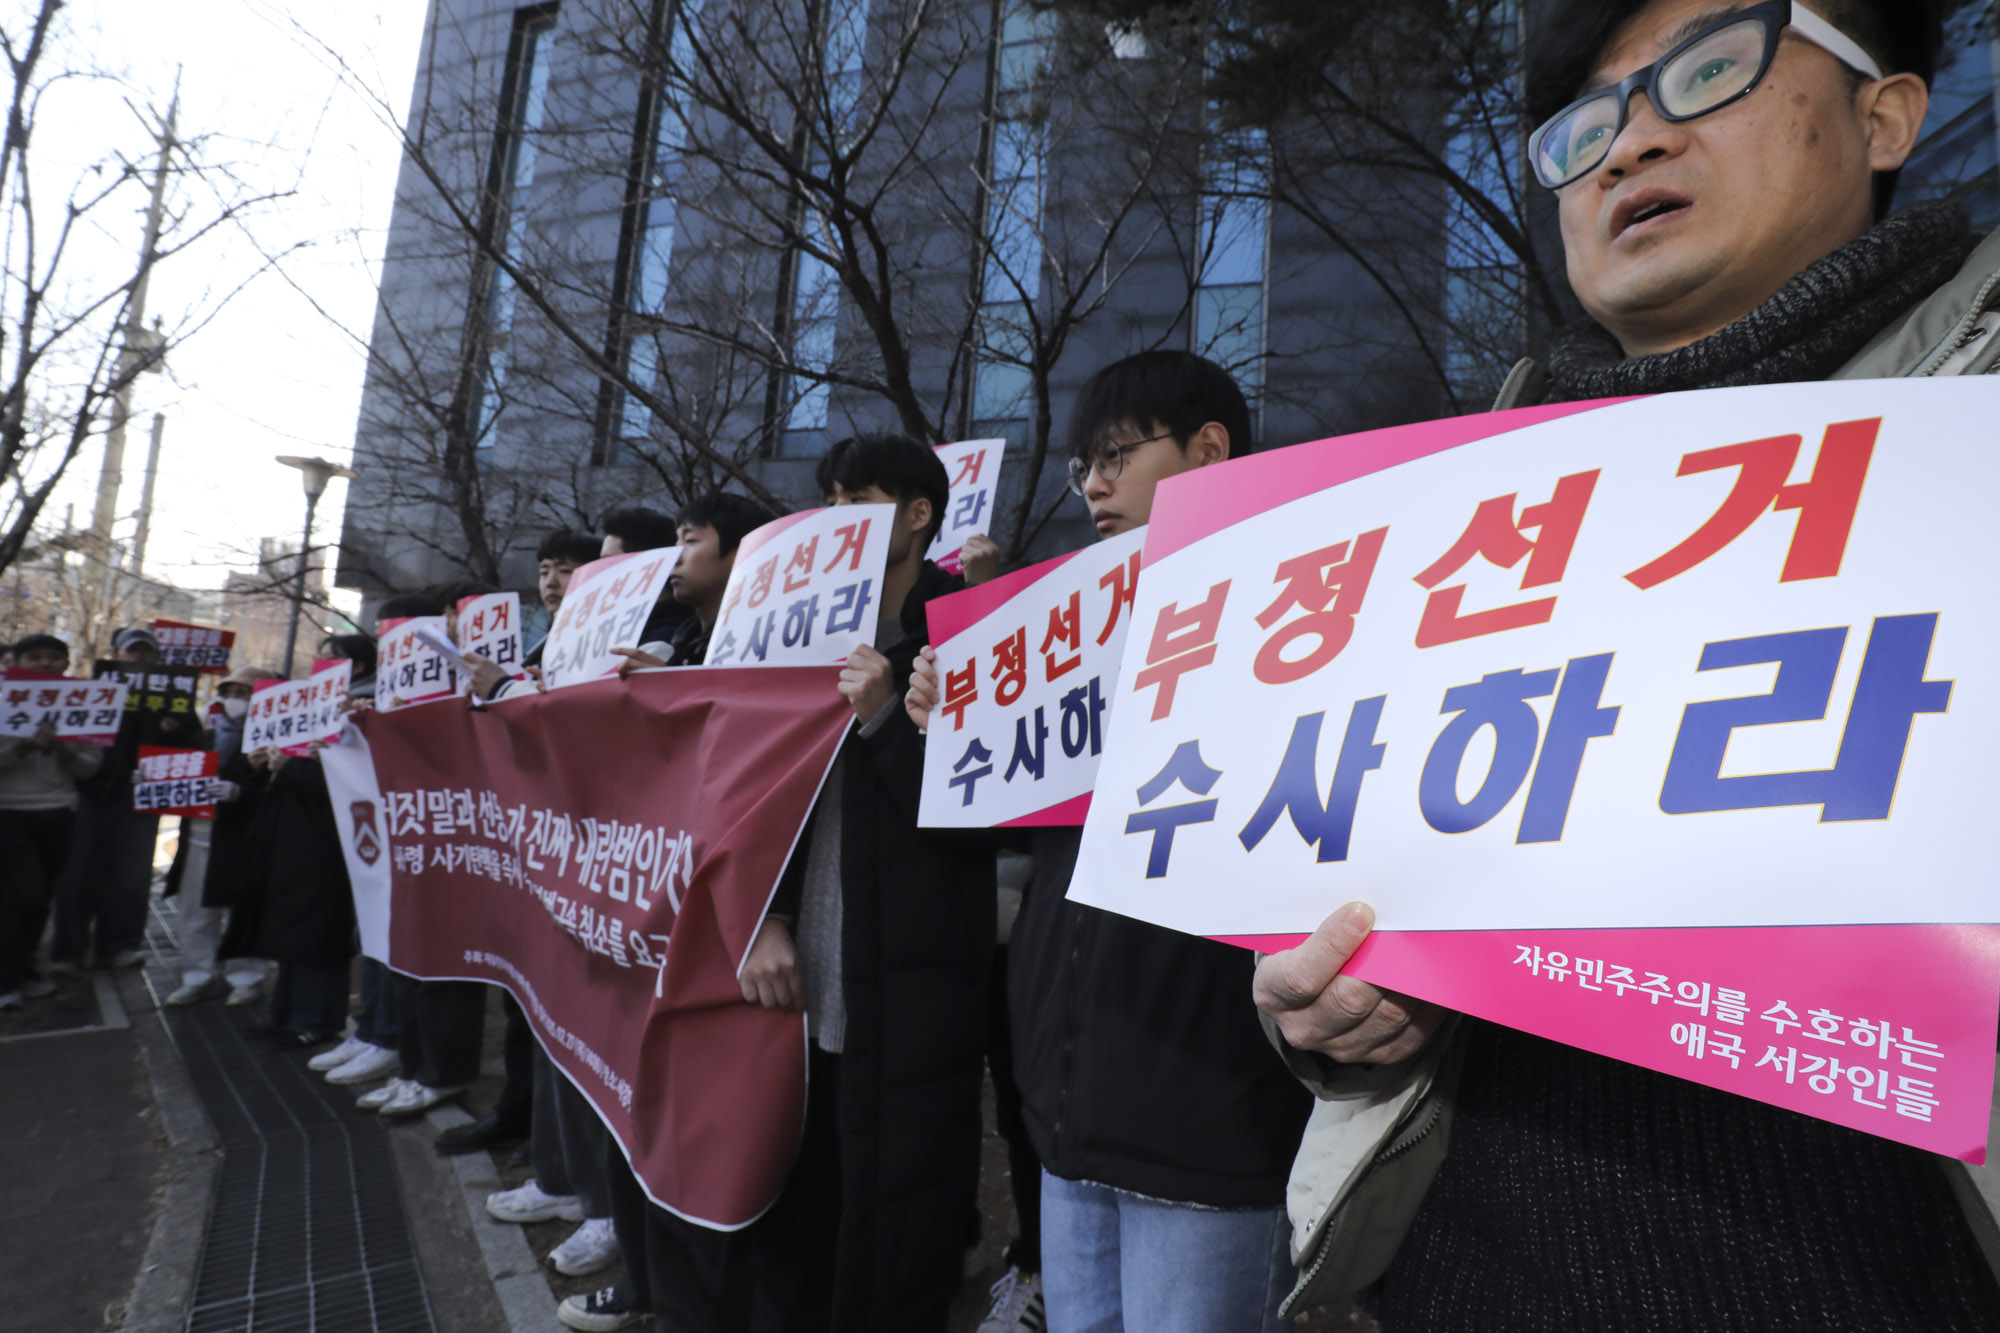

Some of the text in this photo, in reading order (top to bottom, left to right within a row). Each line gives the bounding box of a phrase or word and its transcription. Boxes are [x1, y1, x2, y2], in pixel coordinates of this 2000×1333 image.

[555, 557, 666, 642] 부정선거
[722, 518, 872, 625] 부정선거
[1132, 415, 1884, 723] 부정선거
[547, 600, 651, 686] 수사하라
[711, 578, 873, 665] 수사하라
[941, 549, 1142, 732] 부정선거
[5, 709, 118, 730] 수사하라
[6, 687, 118, 709] 부정선거
[947, 675, 1108, 808] 수사하
[1123, 610, 1956, 880] 수사하라
[1512, 943, 1945, 1073] 자유민주주의를 수호하는
[1669, 1021, 1941, 1123] 애국 서강인들
